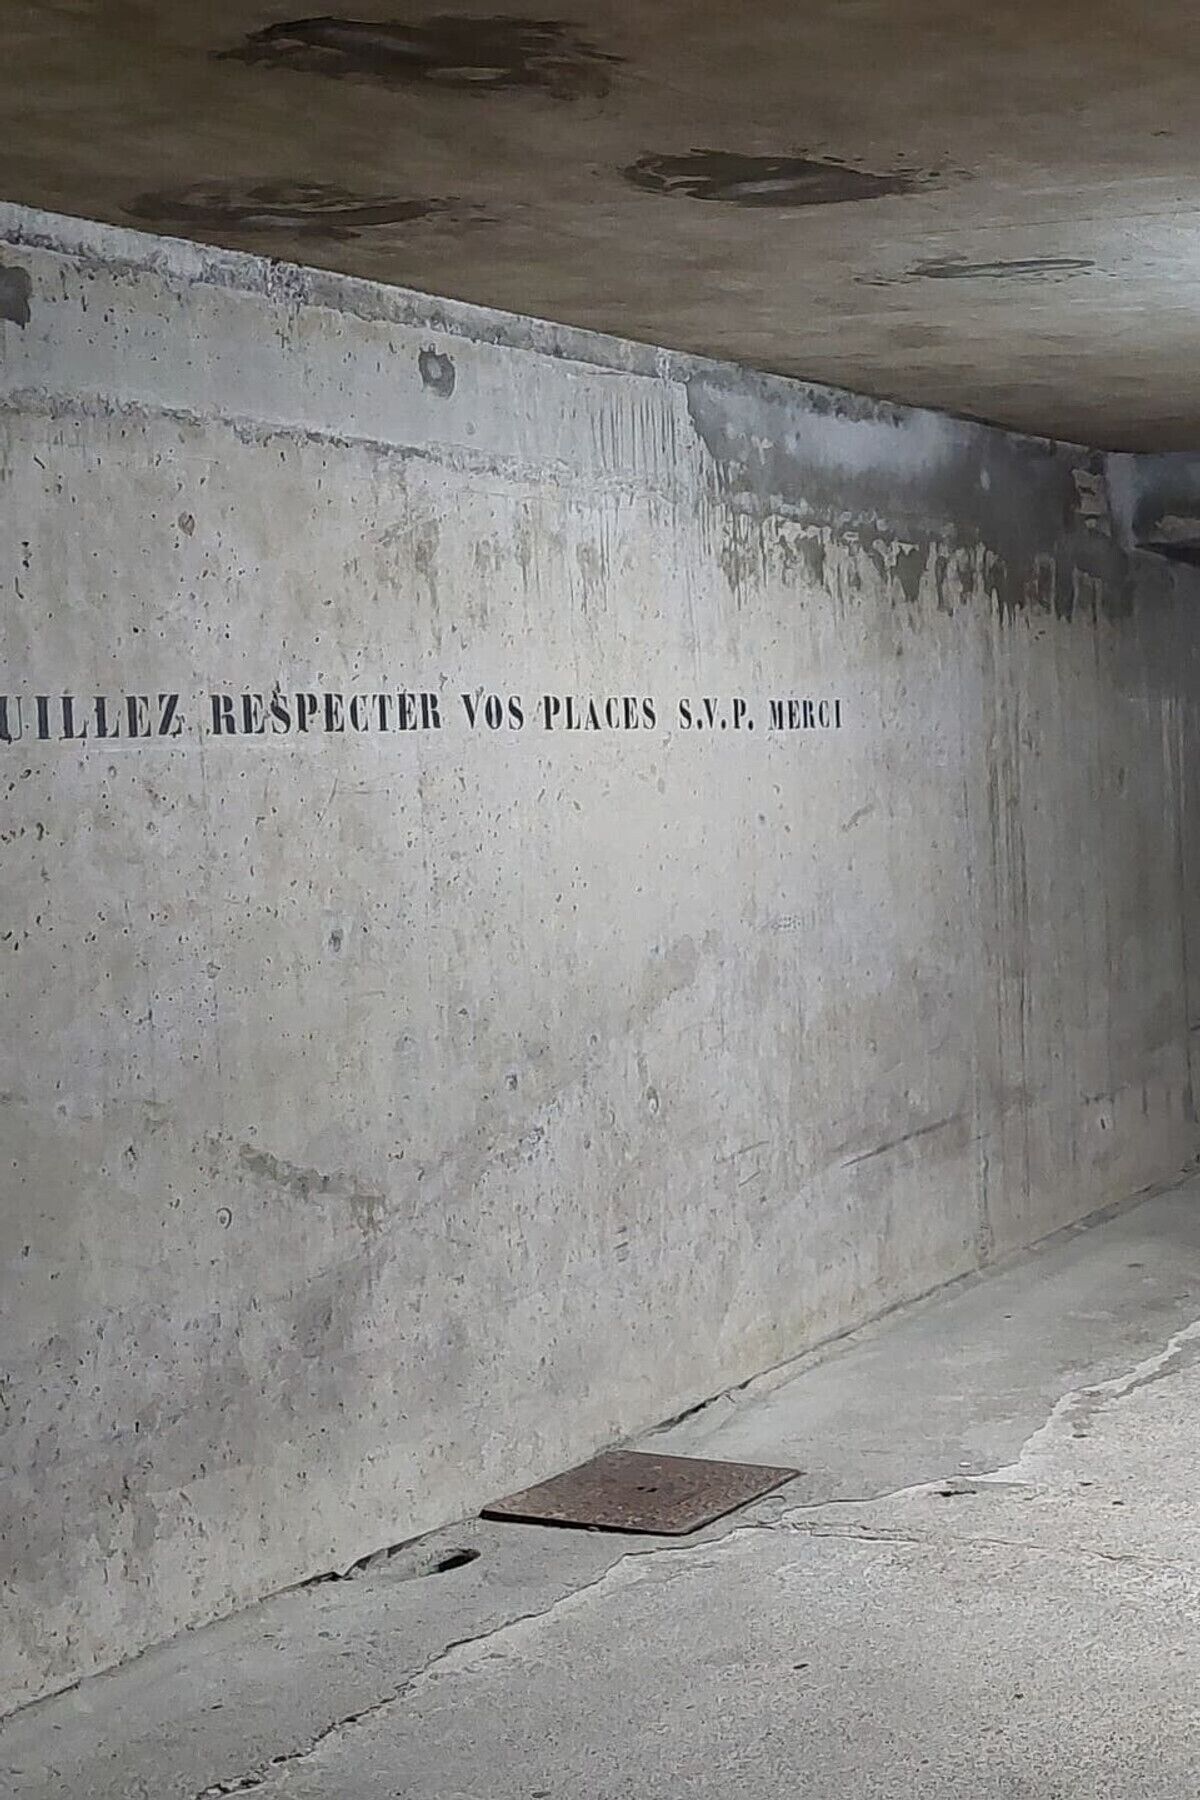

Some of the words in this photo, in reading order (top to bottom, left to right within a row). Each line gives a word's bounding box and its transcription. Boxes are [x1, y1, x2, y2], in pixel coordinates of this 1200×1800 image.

[209, 691, 441, 735] RESPECTER
[461, 693, 524, 730] VOS
[543, 695, 657, 730] PLACES
[679, 697, 754, 731] S.V.P.
[769, 699, 842, 731] MERCI
